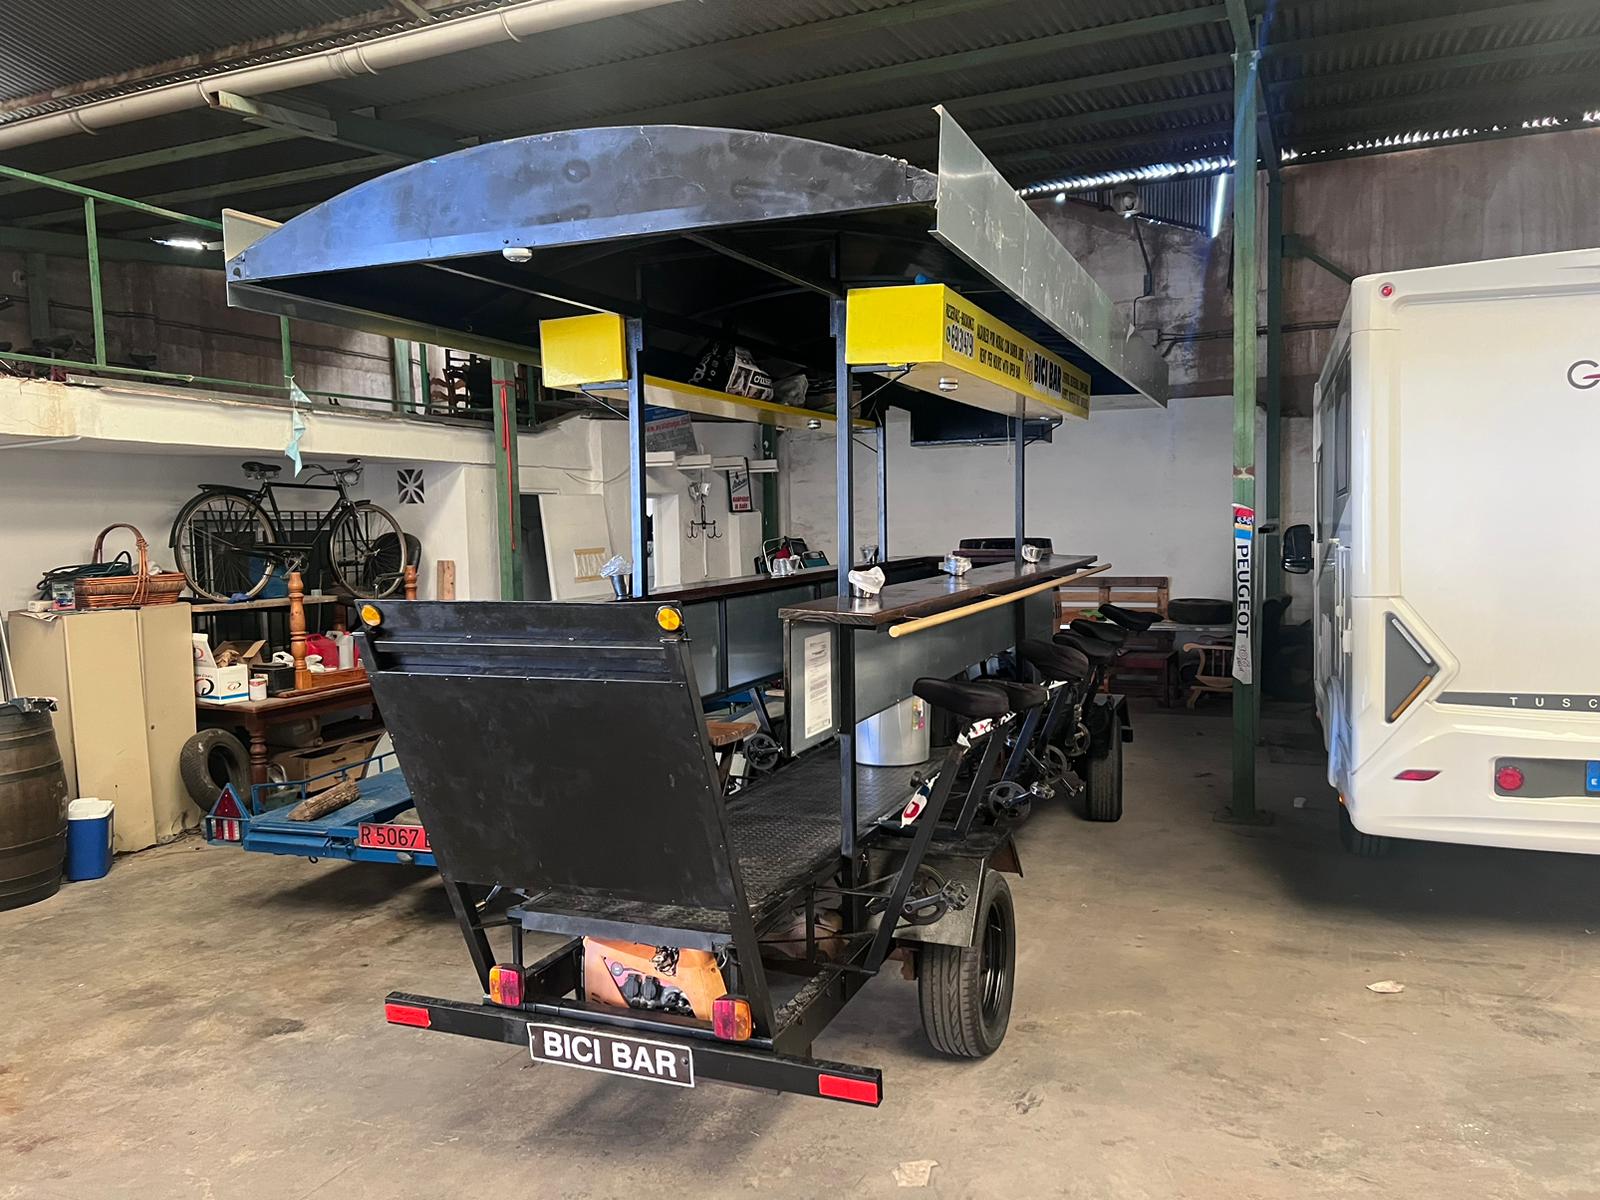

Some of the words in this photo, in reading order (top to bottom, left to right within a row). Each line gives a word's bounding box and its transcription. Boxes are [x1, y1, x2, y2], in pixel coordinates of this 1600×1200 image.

[1034, 353, 1048, 387] BICI
[1048, 361, 1062, 393] BAR
[1237, 544, 1250, 639] PEUGEOT
[361, 826, 371, 844] R
[376, 827, 419, 847] 5067
[543, 1031, 601, 1065] BICI
[611, 1042, 677, 1078] BAR
